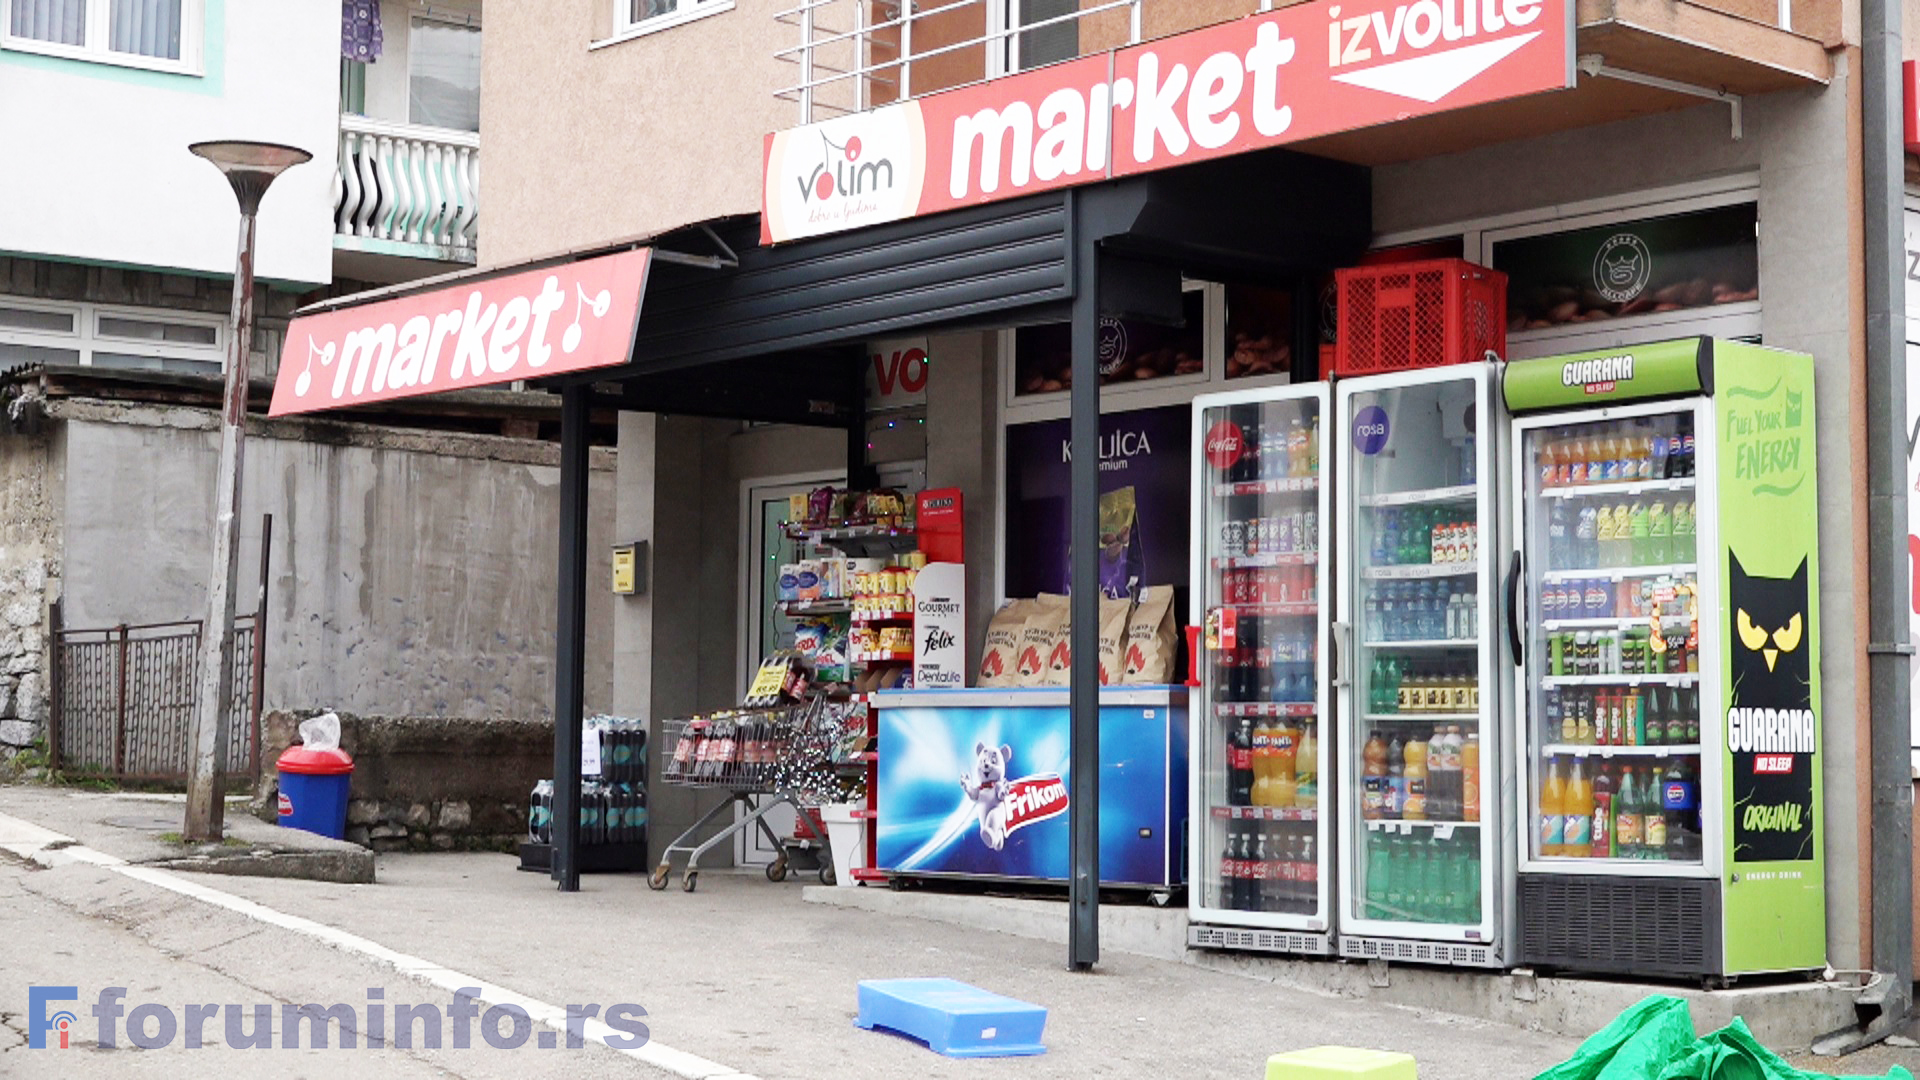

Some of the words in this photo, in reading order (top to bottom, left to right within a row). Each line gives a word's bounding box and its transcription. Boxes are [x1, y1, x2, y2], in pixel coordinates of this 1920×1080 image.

[949, 21, 1296, 200] market
[797, 150, 893, 204] volim
[331, 275, 565, 400] market
[1563, 355, 1633, 386] GUARANA
[1062, 430, 1151, 463] KLJICA
[1357, 423, 1385, 437] rosa
[1736, 437, 1801, 480] ENERGY
[918, 602, 960, 615] GOURMET
[1728, 707, 1815, 753] GUARANA
[1756, 757, 1768, 770] NO
[1768, 757, 1792, 770] SLEEP
[1006, 779, 1066, 821] Frikom
[1743, 801, 1802, 832] ORIGINAL
